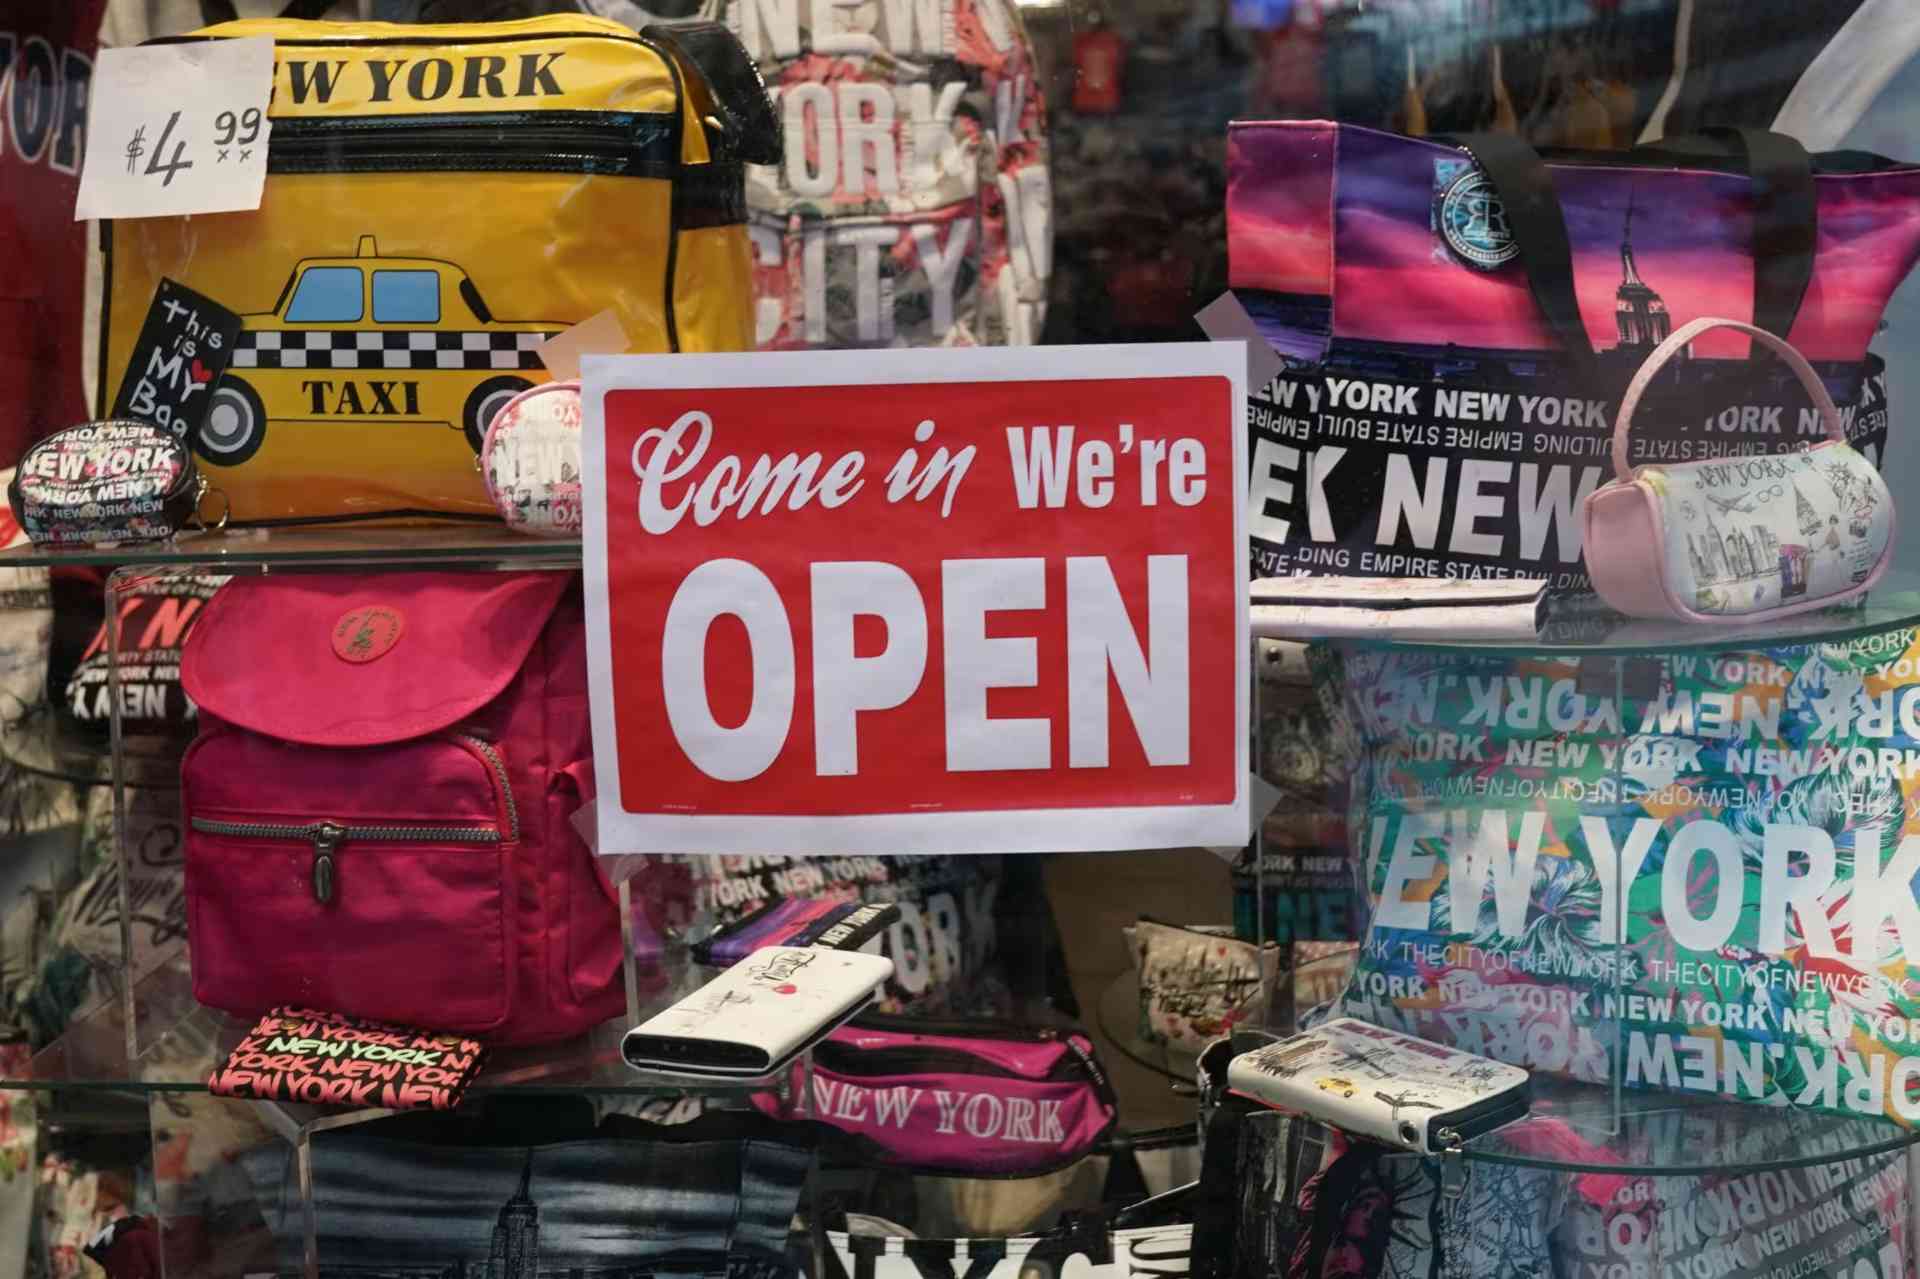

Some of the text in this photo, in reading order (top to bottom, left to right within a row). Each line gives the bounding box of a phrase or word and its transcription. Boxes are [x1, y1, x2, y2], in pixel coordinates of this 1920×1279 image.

[366, 52, 565, 103] YORK
[212, 106, 262, 145] 99
[172, 335, 197, 358] is
[302, 380, 421, 416] TAXI
[1325, 376, 1421, 416] YORK
[1433, 388, 1512, 422] NEW
[1517, 394, 1609, 429] YORK
[1374, 421, 1441, 447] STATE
[1444, 426, 1524, 452] EMPIRE
[87, 447, 178, 478] YORK
[631, 410, 1208, 535] Come in We're
[1374, 451, 1603, 564] NEW
[1360, 552, 1440, 579] EMPIRE
[660, 553, 1192, 783] OPEN
[1706, 657, 1788, 688] YORK
[1639, 690, 1783, 741] NEW
[1502, 737, 1590, 769] NEW
[1723, 746, 1816, 777] NEW
[1577, 813, 1920, 960] YORK
[1357, 970, 1427, 1001] YORK
[1602, 993, 1675, 1024] NEW
[1680, 998, 1769, 1032] YORK
[266, 1036, 348, 1058] NEW
[350, 1039, 442, 1066] YORK
[321, 1022, 412, 1048] YORK
[228, 1052, 322, 1075] YORK
[318, 1057, 401, 1081] NEW
[1624, 1030, 1768, 1099] NEW
[285, 1071, 379, 1105] YORK
[794, 1074, 1067, 1145] NEW YORK
